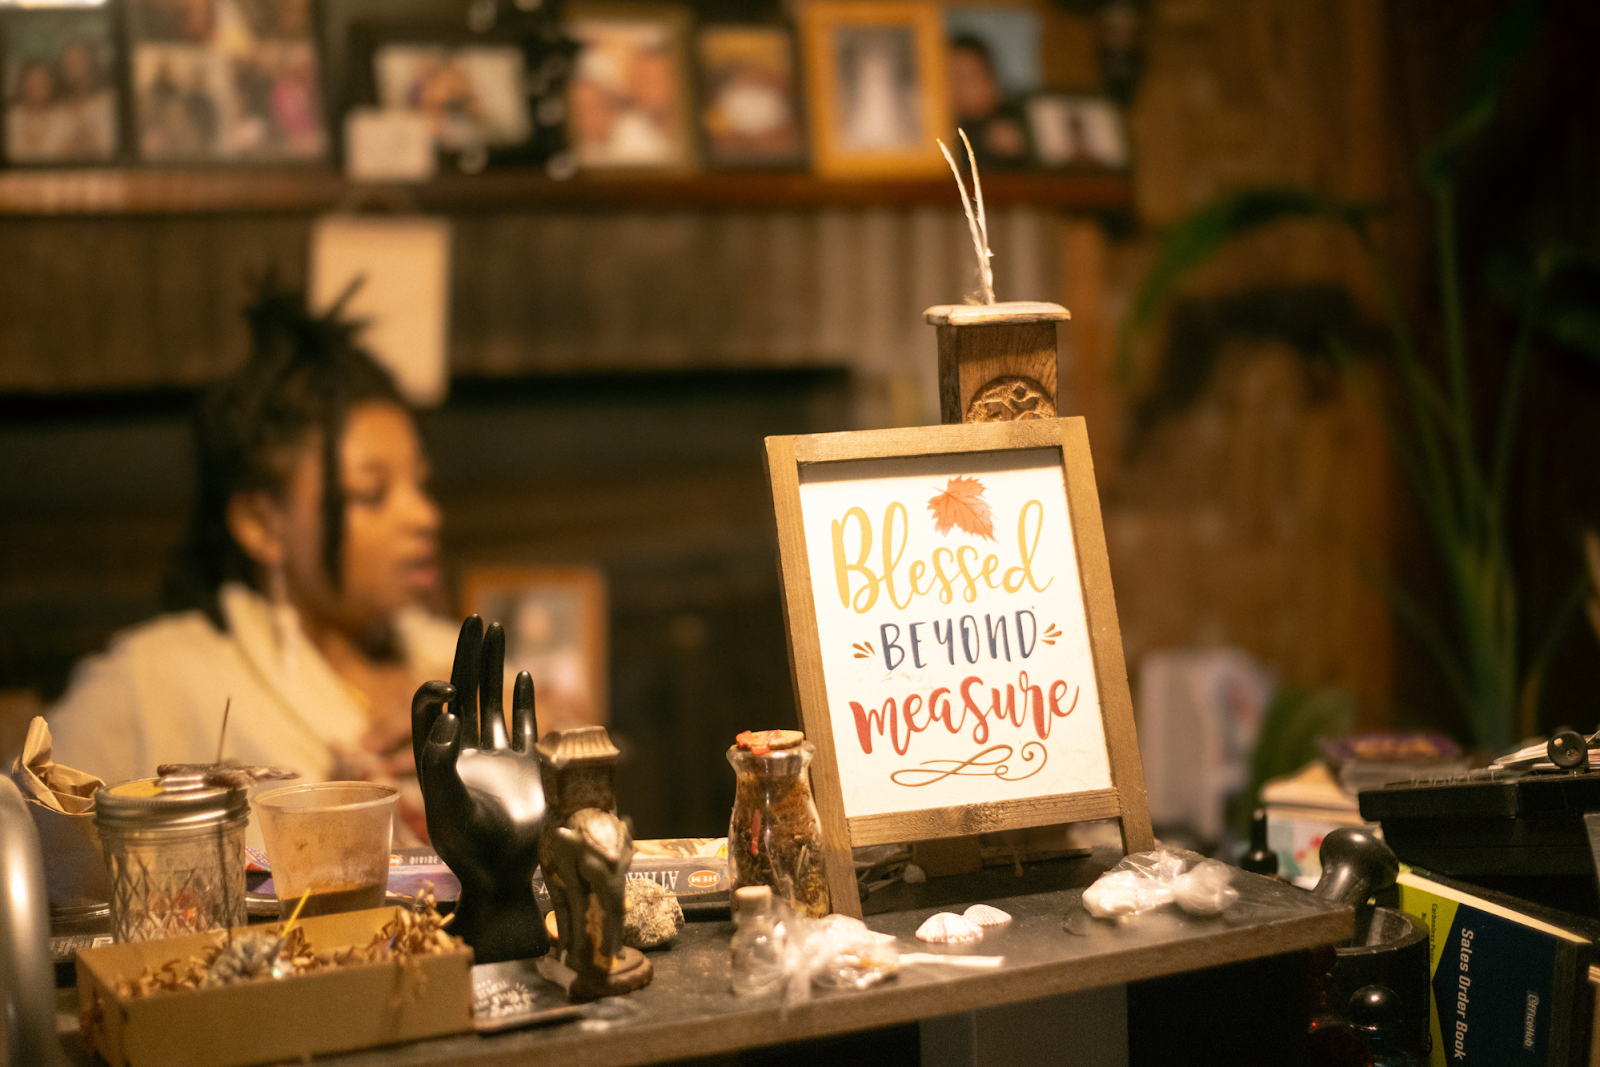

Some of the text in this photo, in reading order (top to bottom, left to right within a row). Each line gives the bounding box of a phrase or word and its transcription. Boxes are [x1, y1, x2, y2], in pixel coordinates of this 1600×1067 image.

[831, 499, 1054, 614] Blessed
[880, 609, 1037, 670] BEYOND
[848, 670, 1080, 756] measure
[690, 874, 718, 883] HEM
[1454, 928, 1474, 1060] Sales Order Book
